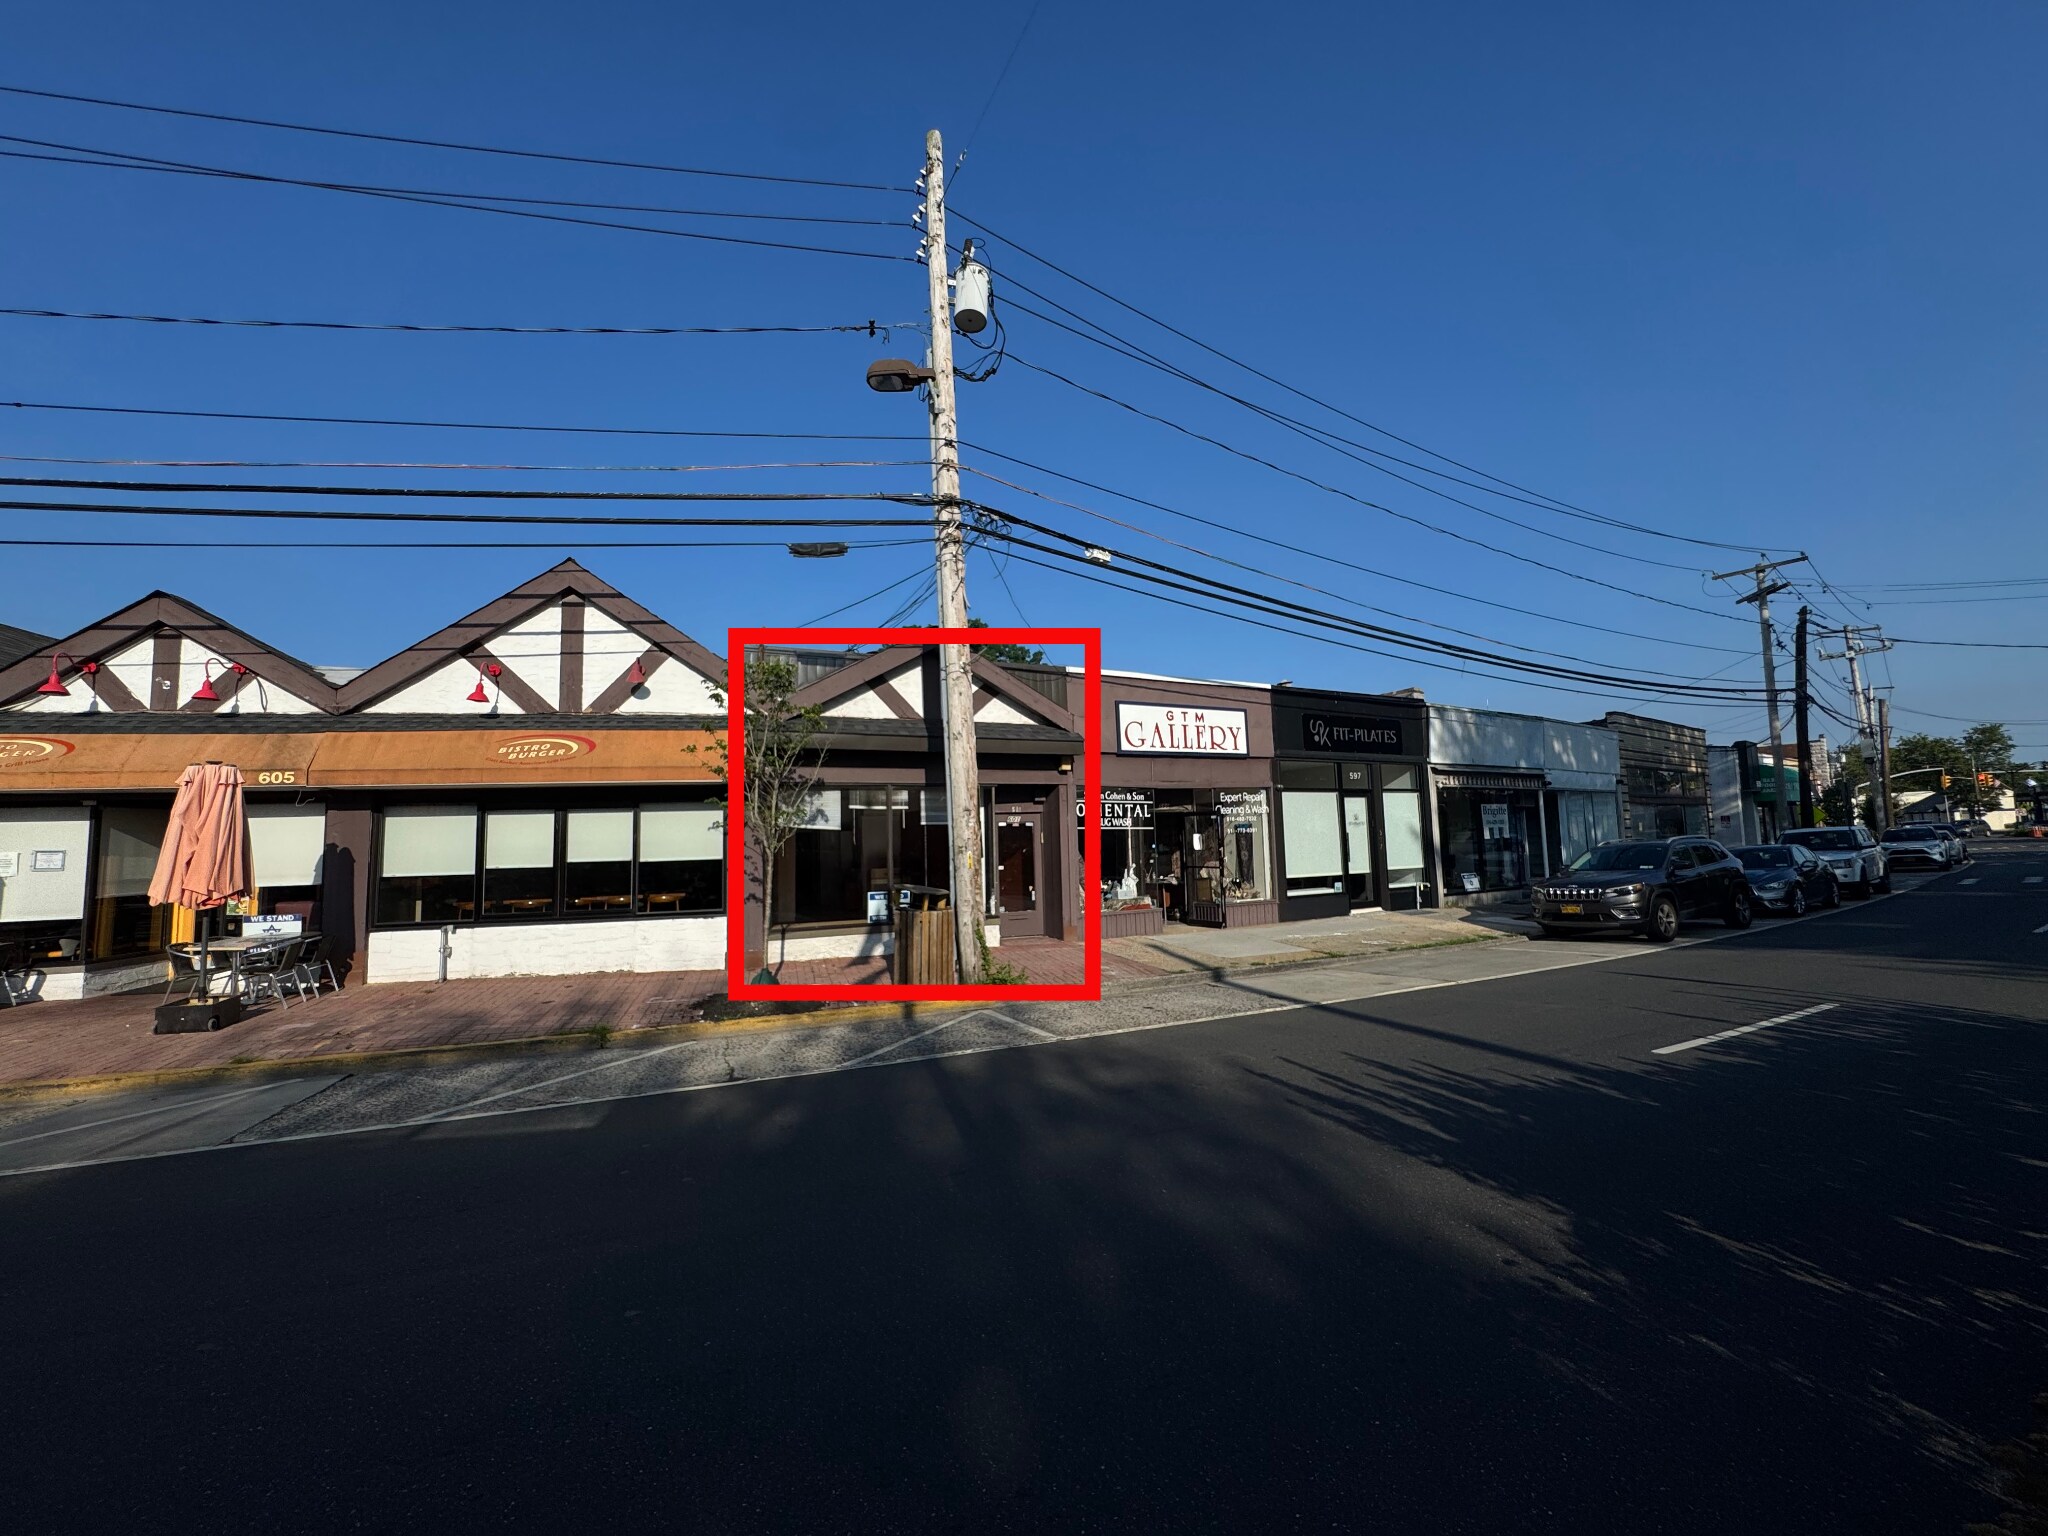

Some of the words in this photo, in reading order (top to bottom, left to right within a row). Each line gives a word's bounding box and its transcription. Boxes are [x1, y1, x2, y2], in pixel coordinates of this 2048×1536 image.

[1166, 710, 1205, 722] GTM
[1124, 721, 1241, 750] GALLERY
[1333, 726, 1397, 744] FIT-PILATES
[498, 743, 550, 754] BISTRO
[508, 748, 566, 760] BURGER
[258, 771, 295, 784] 605
[1349, 772, 1361, 780] 597
[1105, 791, 1126, 800] Cohen
[1126, 793, 1132, 801] &
[1132, 792, 1145, 801] Son
[1220, 792, 1242, 804] Expert
[1242, 791, 1264, 803] Repair
[1076, 803, 1151, 818] OENTAL
[1245, 804, 1250, 813] &
[1251, 804, 1270, 813] Wash
[1482, 805, 1507, 818] Brigitte
[1111, 818, 1132, 826] WASH
[250, 915, 264, 923] WE
[266, 914, 294, 922] STAND
